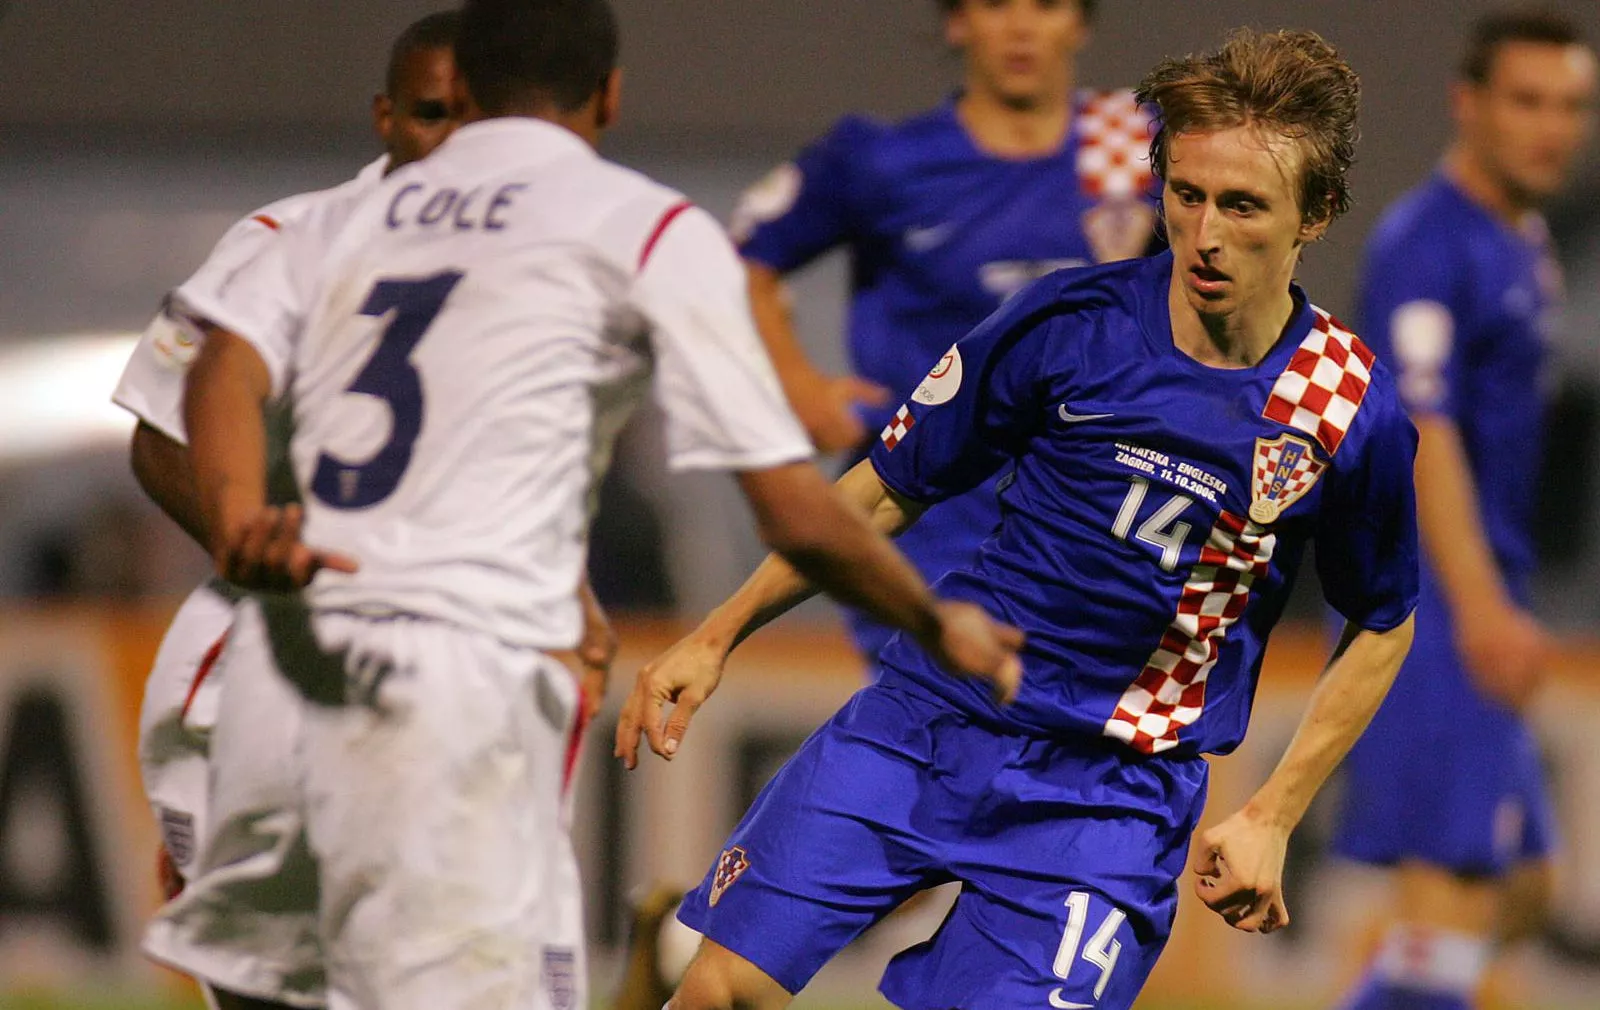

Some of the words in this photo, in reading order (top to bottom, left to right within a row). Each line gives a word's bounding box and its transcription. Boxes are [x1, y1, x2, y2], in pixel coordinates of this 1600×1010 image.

[385, 182, 530, 233] COLE
[310, 268, 467, 512] 3
[1177, 462, 1227, 495] ENGLESKA
[1271, 449, 1298, 493] HNS
[1111, 475, 1193, 572] 14
[1052, 890, 1127, 1001] 14
